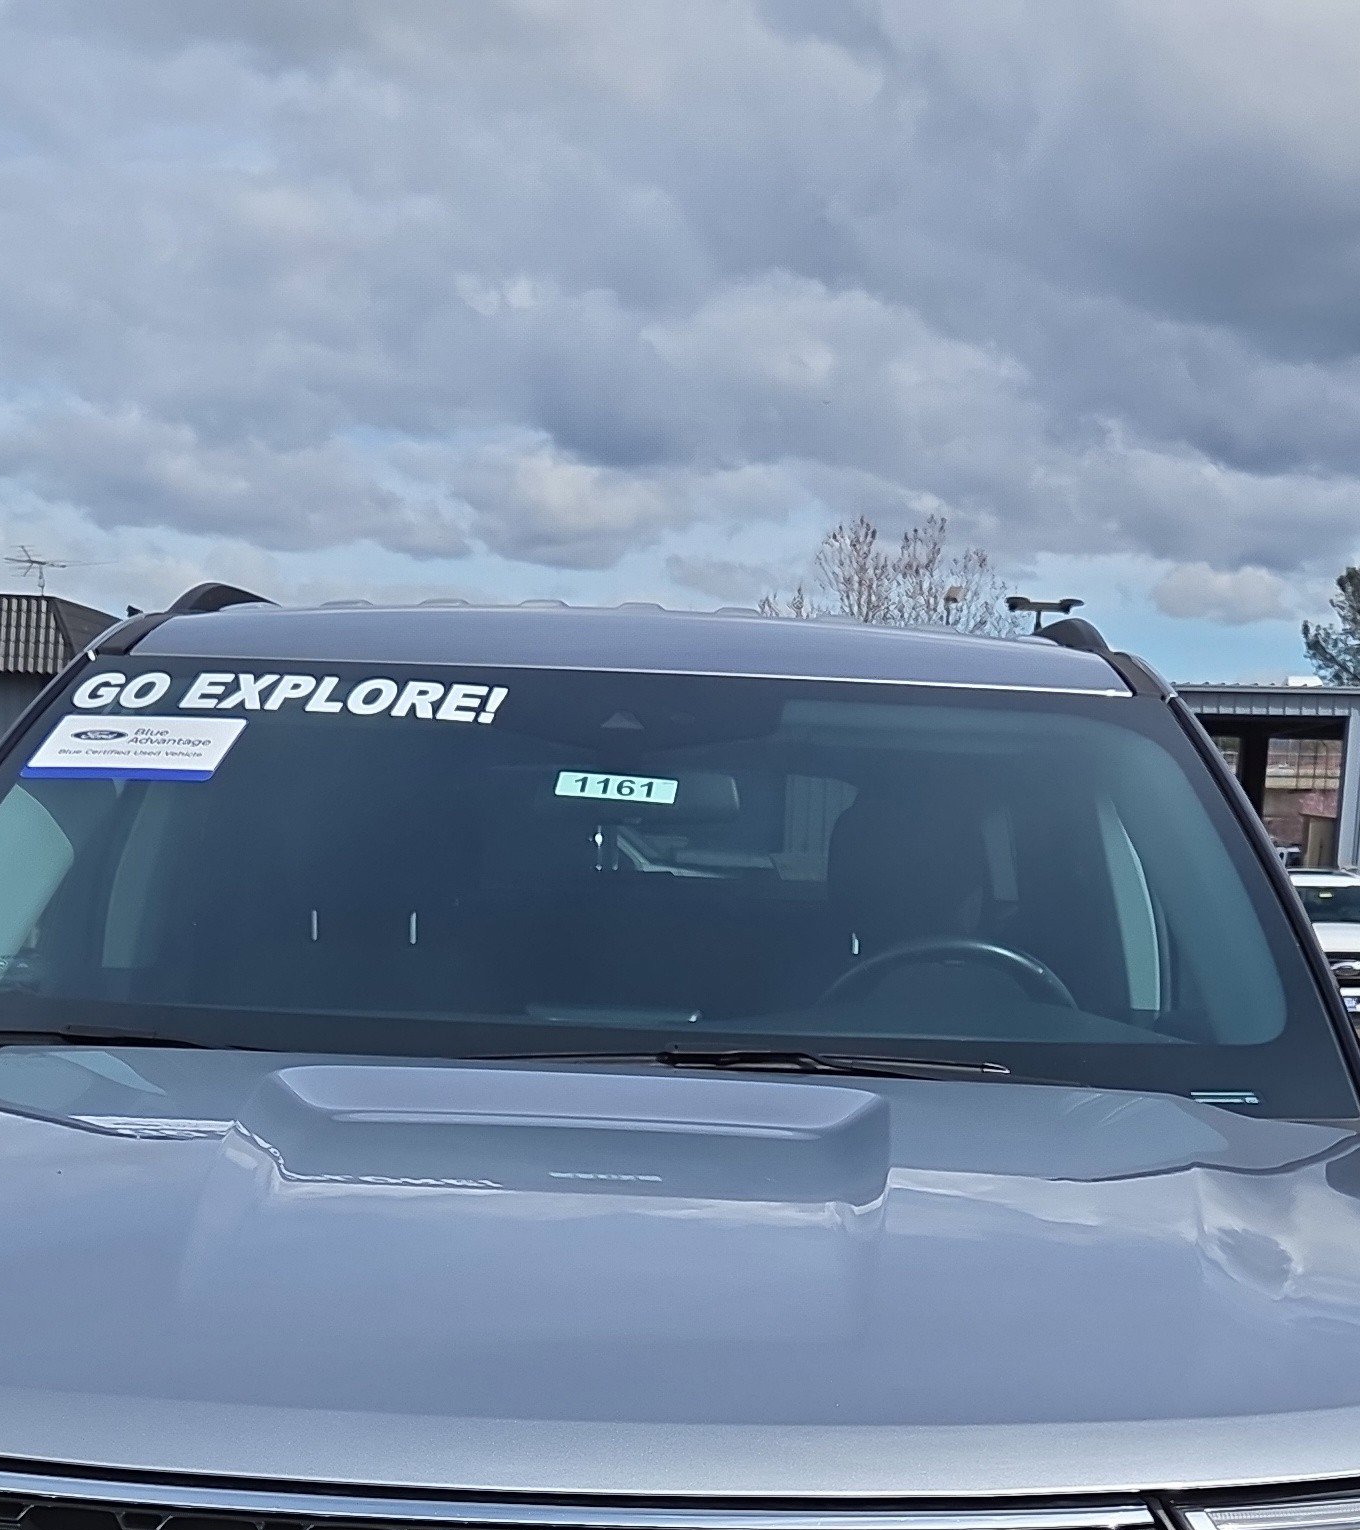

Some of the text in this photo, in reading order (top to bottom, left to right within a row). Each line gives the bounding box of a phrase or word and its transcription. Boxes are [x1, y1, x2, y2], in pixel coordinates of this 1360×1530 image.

[72, 672, 508, 724] GO EXPLORE!
[133, 727, 169, 737] Blue
[127, 737, 211, 748] Advantage
[574, 775, 656, 798] 1161
